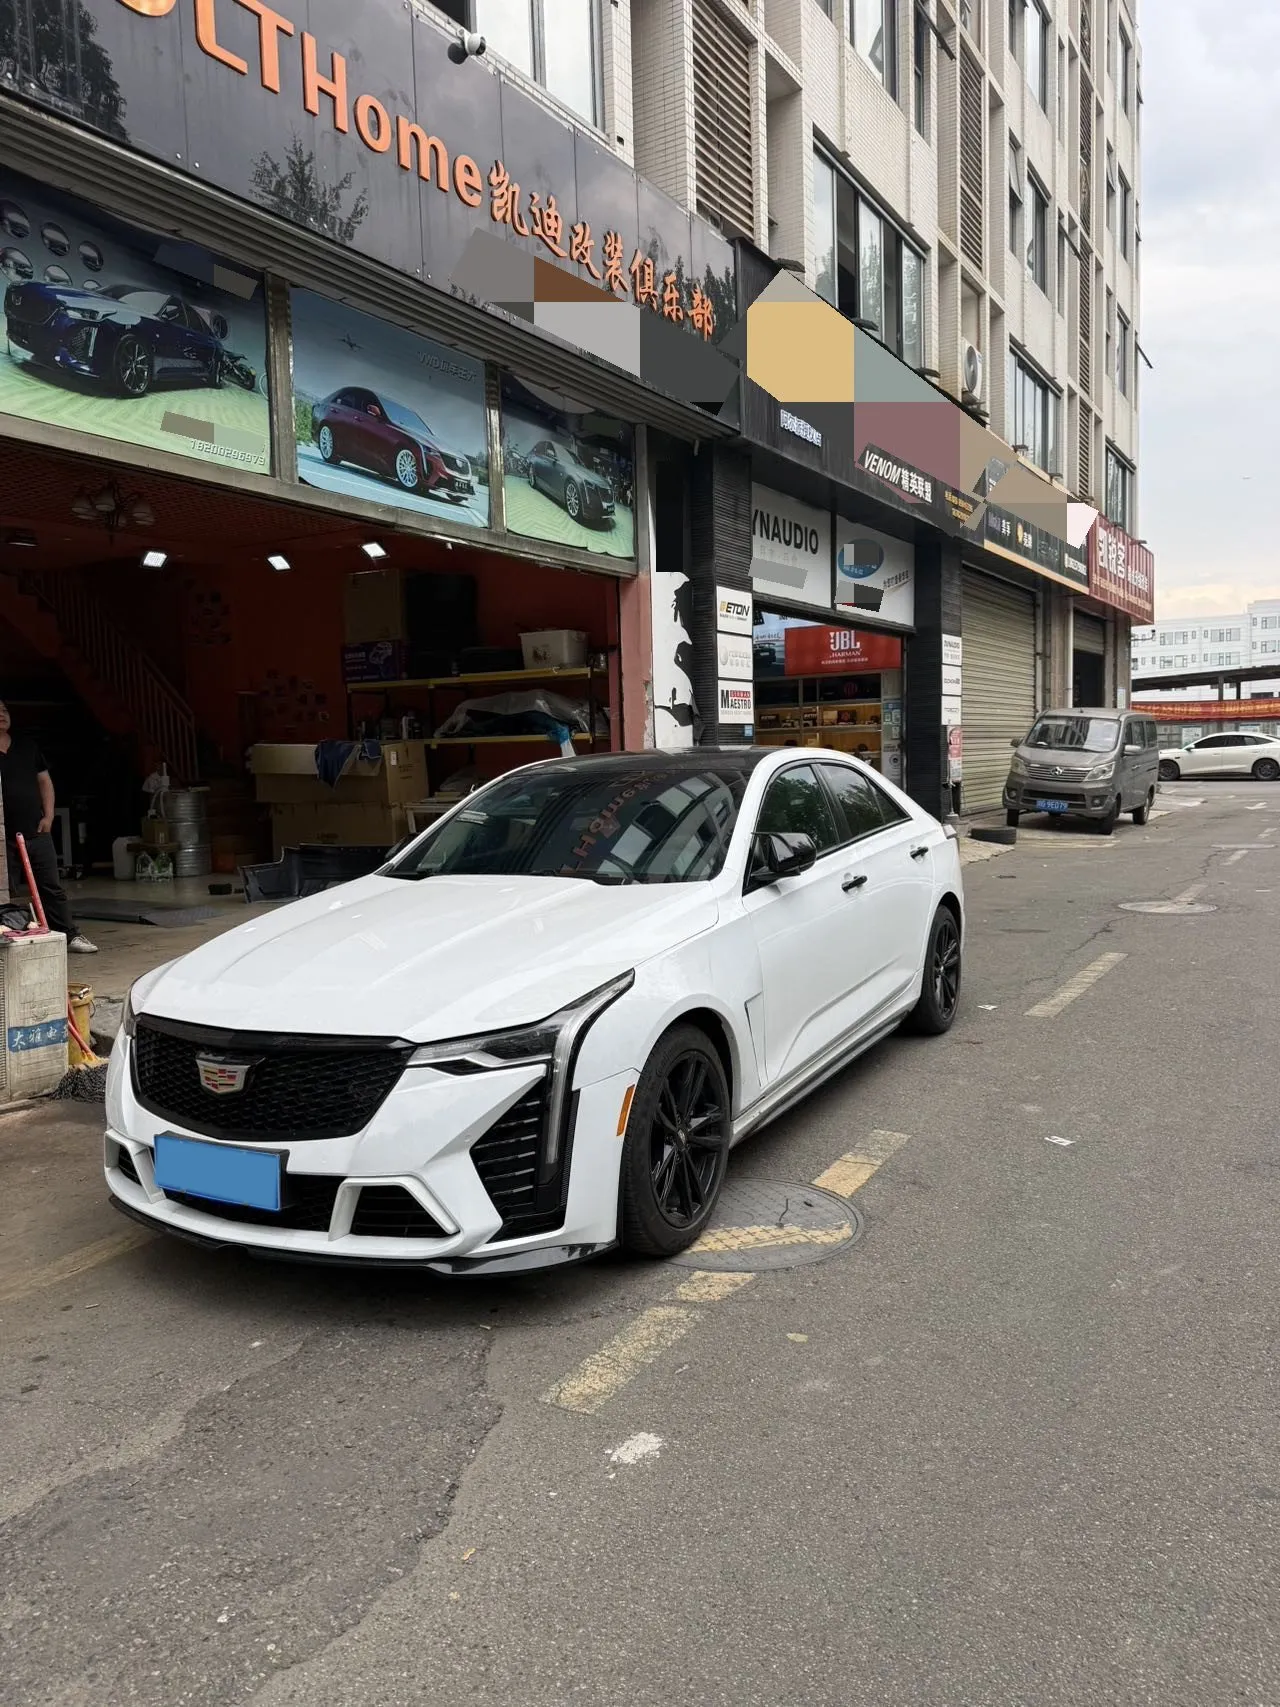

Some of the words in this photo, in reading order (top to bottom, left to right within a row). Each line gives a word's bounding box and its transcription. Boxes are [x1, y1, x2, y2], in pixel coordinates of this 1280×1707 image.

[487, 160, 715, 342] 凯迪改装俱乐部
[864, 450, 901, 485] VENOM
[829, 630, 861, 651] JBL
